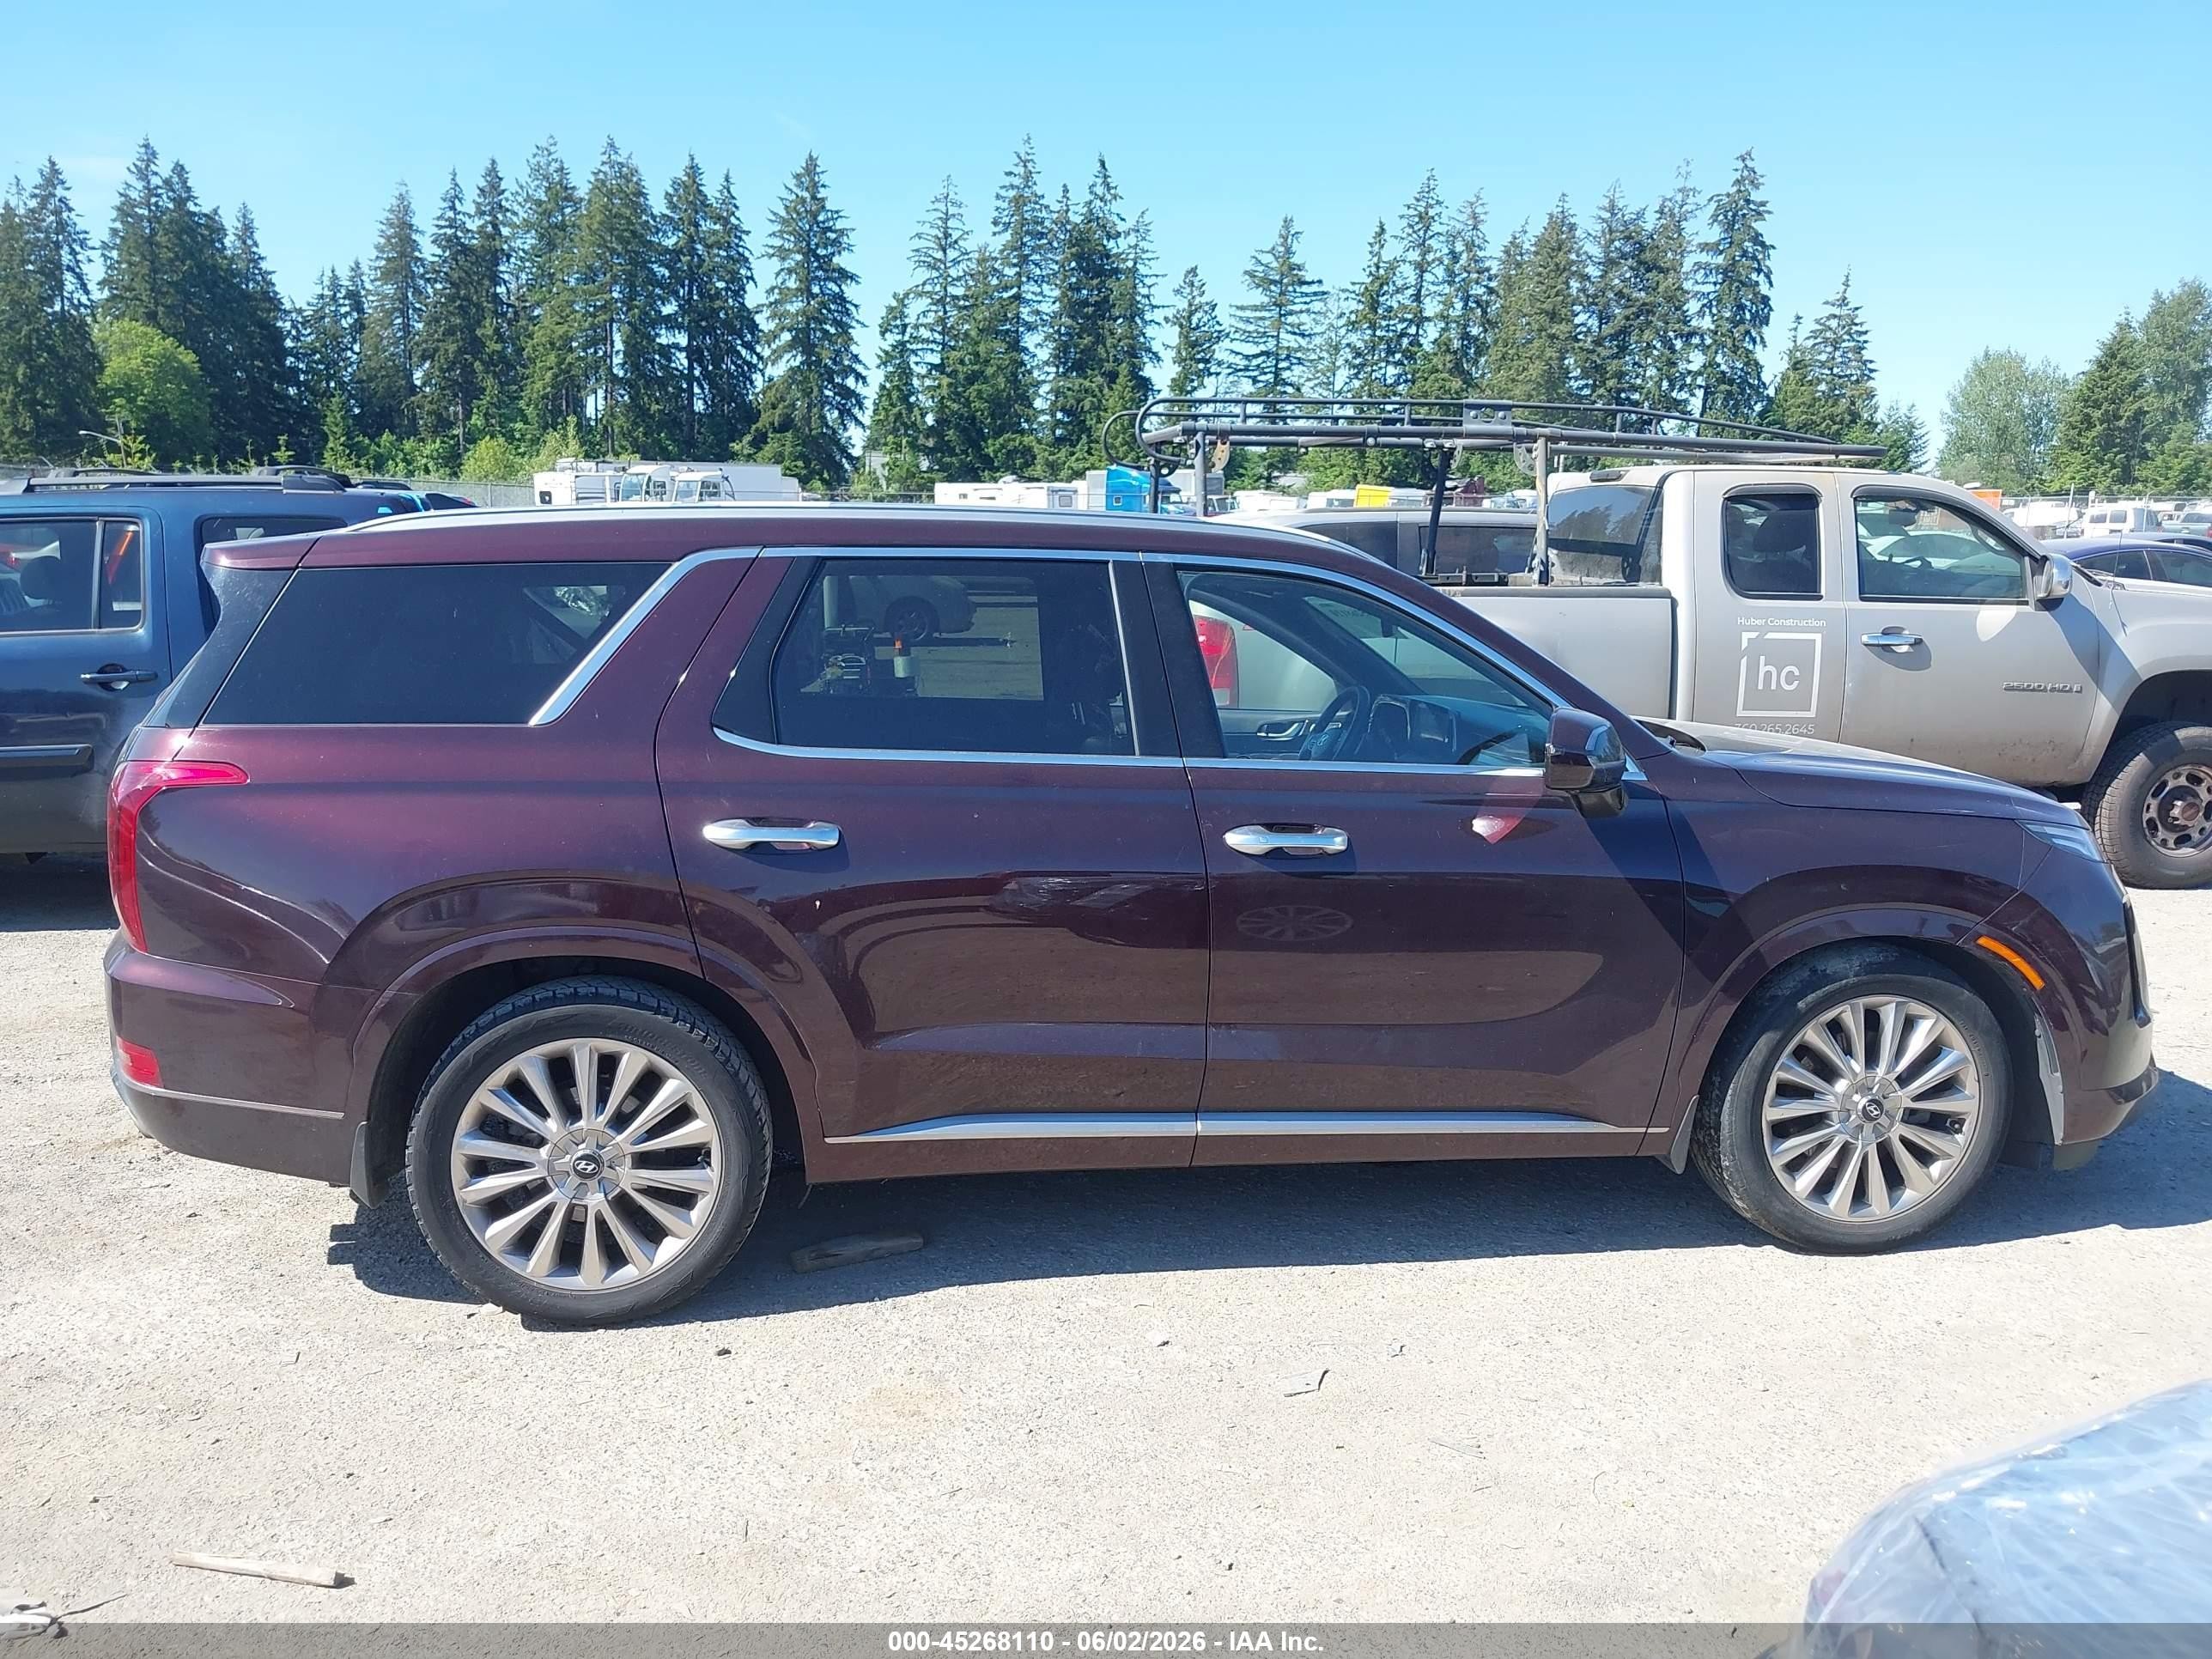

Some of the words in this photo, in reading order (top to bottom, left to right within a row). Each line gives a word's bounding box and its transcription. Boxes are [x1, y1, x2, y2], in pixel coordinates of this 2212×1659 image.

[1737, 617, 1766, 626] Huber
[1767, 617, 1826, 627] Construction
[1758, 655, 1800, 690] hc
[2002, 681, 2045, 692] 2500
